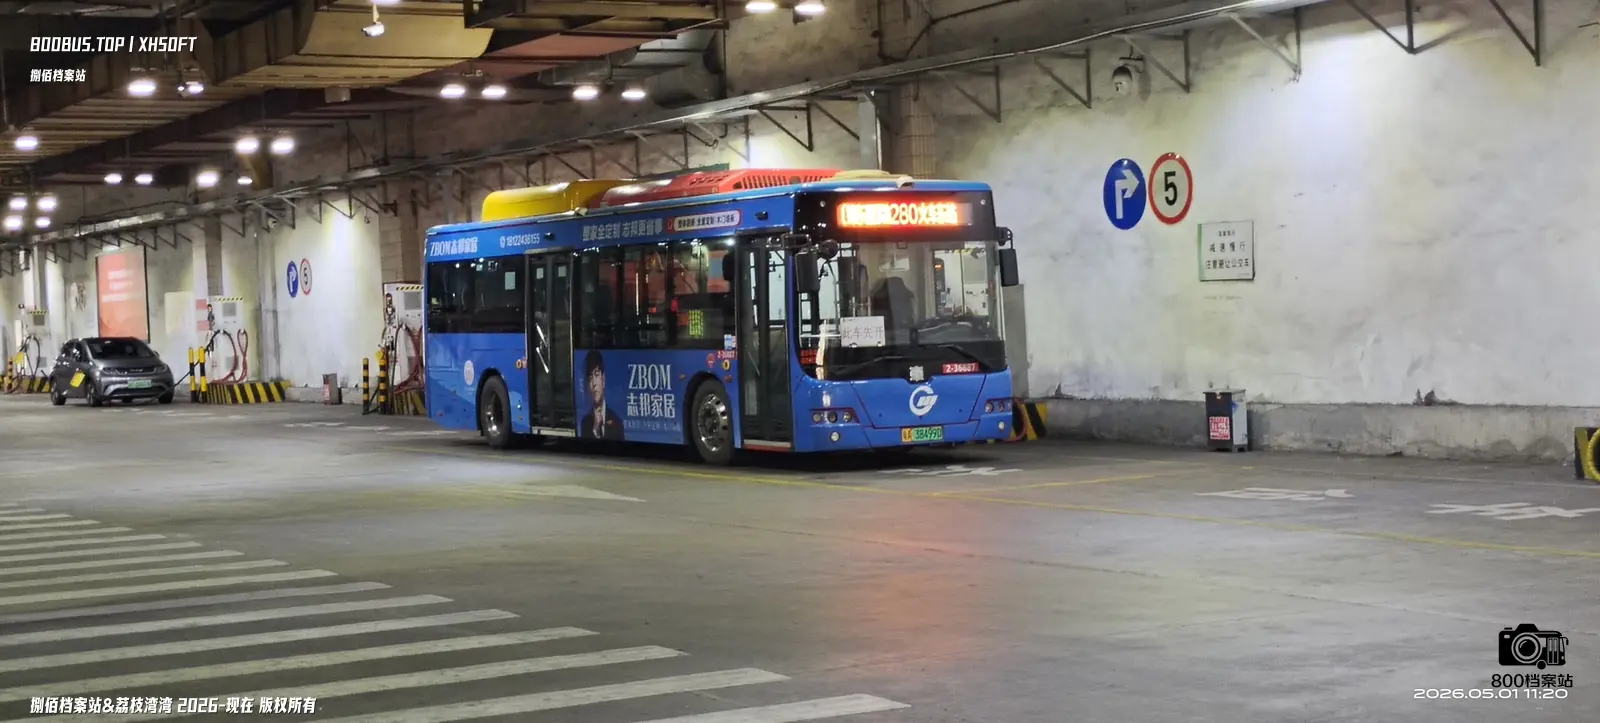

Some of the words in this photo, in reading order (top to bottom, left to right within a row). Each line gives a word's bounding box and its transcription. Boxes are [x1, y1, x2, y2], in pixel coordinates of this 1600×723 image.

[1163, 171, 1178, 206] 5
[628, 364, 672, 390] ZBOM
[626, 393, 676, 418] 志邦家居
